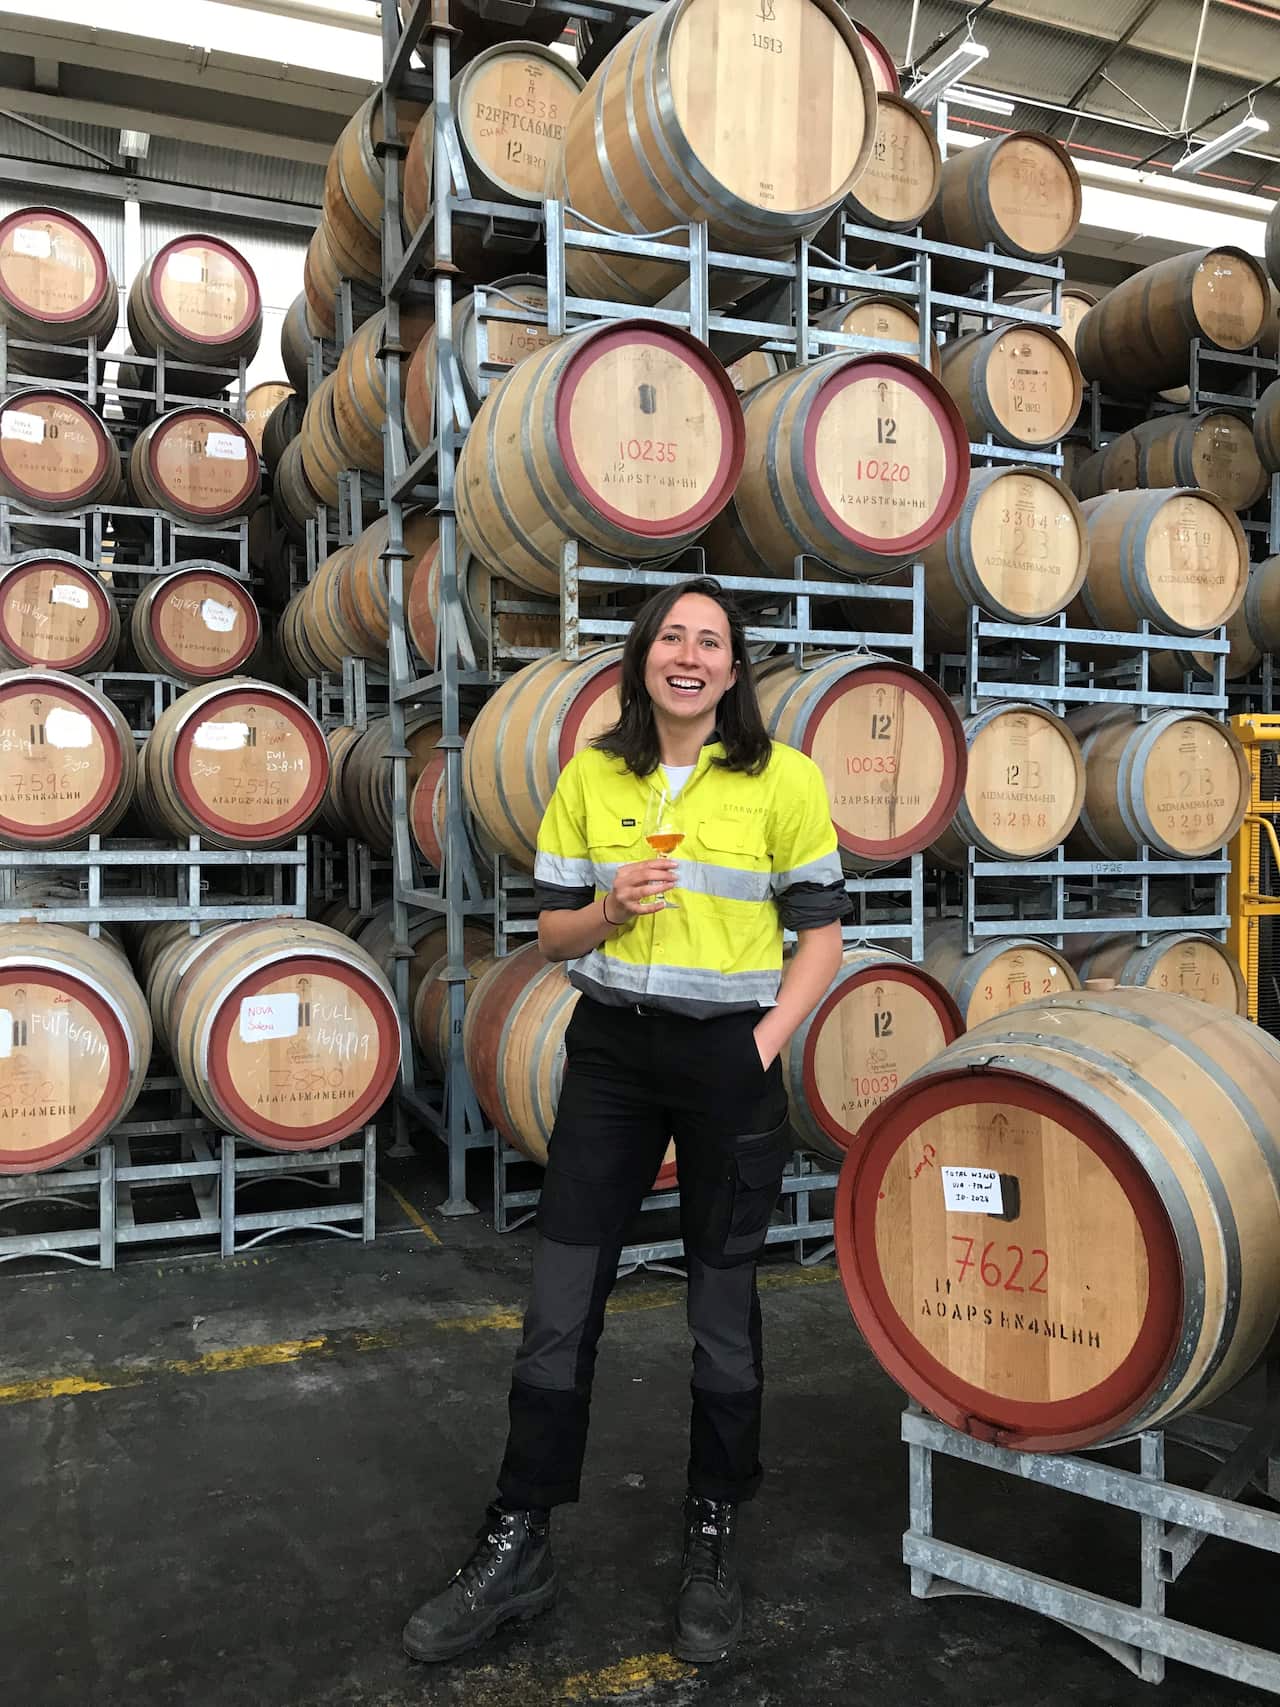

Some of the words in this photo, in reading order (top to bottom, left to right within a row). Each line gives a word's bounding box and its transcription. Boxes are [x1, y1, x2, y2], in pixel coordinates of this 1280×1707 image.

[752, 33, 783, 54] 11513
[508, 94, 558, 119] 10538
[876, 416, 898, 444] 12
[619, 438, 679, 463] 10235
[856, 460, 911, 483] 10220
[871, 713, 892, 740] 12
[846, 755, 897, 775] 10033
[8, 773, 70, 793] 7596
[984, 978, 1052, 1001] 3182
[1160, 973, 1220, 988] 3176
[248, 1006, 274, 1016] NOVA
[312, 1003, 353, 1021] FULL
[873, 1011, 894, 1039] 12
[852, 1073, 899, 1097] 10039
[951, 1235, 1049, 1293] 7622
